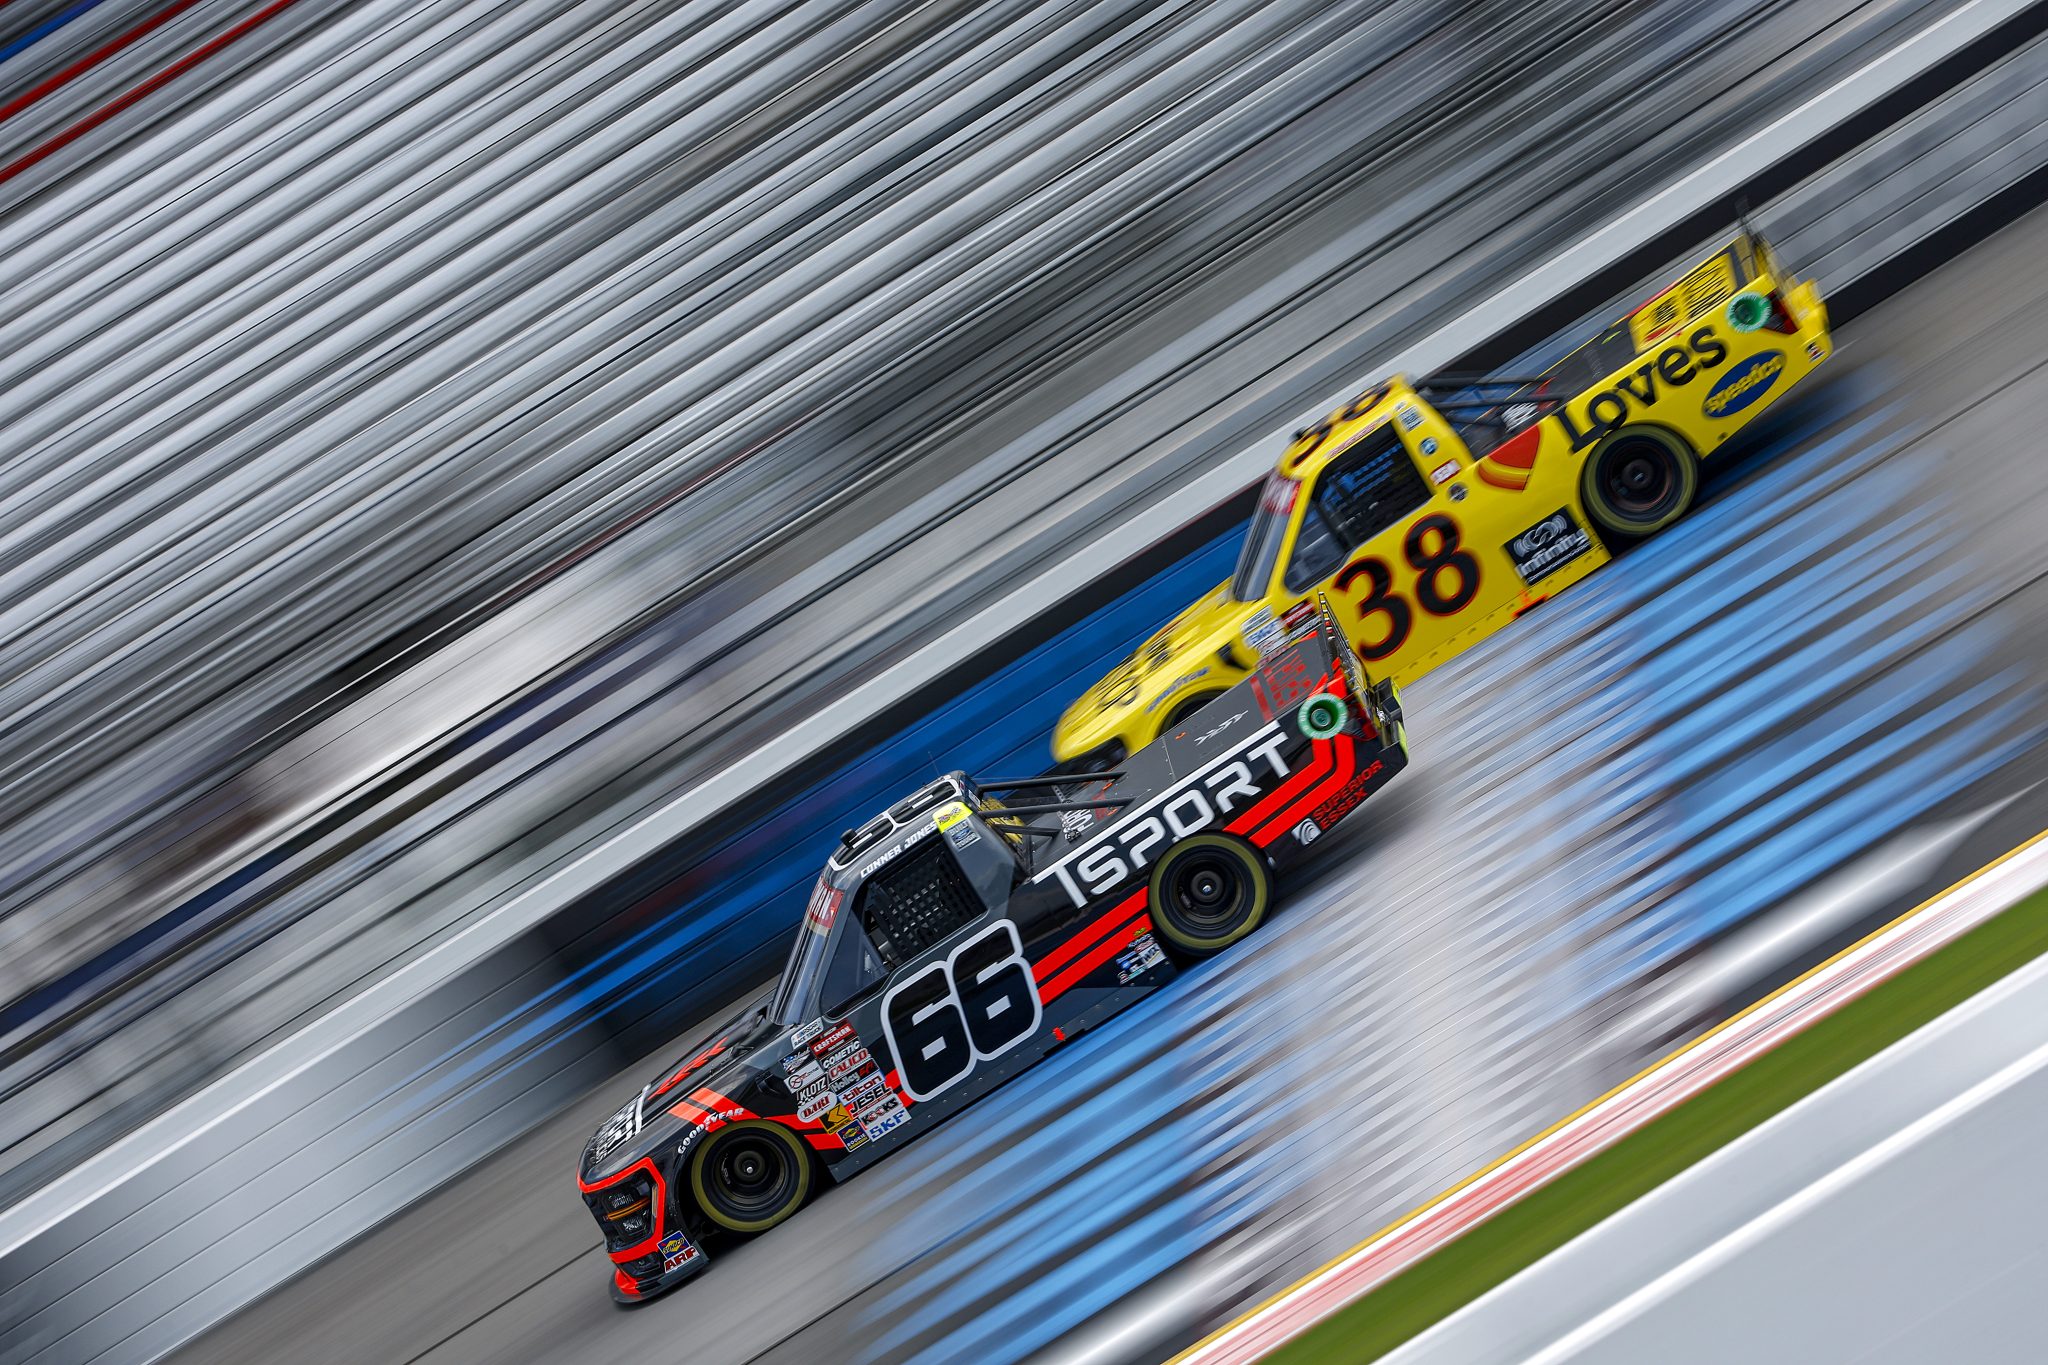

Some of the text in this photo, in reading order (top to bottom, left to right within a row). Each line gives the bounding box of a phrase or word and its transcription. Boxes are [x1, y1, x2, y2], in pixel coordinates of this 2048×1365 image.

[1551, 326, 1727, 454] Loves
[1331, 512, 1482, 662] 38
[1312, 760, 1384, 821] SUPERIOR
[1320, 787, 1368, 830] ESSEX
[861, 844, 902, 879] CONNER
[904, 821, 938, 850] JONES
[881, 919, 1042, 1102] 66
[814, 1026, 851, 1052] CRAFTSMAN
[823, 1041, 860, 1068] COMETIC
[829, 1049, 868, 1079] CALICO
[799, 1076, 827, 1100] KLOTZ
[830, 1073, 860, 1092] Holley
[843, 1076, 882, 1102] tilton
[849, 1082, 893, 1114] JESEL
[861, 1097, 898, 1125] KOOKS
[869, 1110, 905, 1139] SKF
[677, 1107, 744, 1154] GOODYEAR
